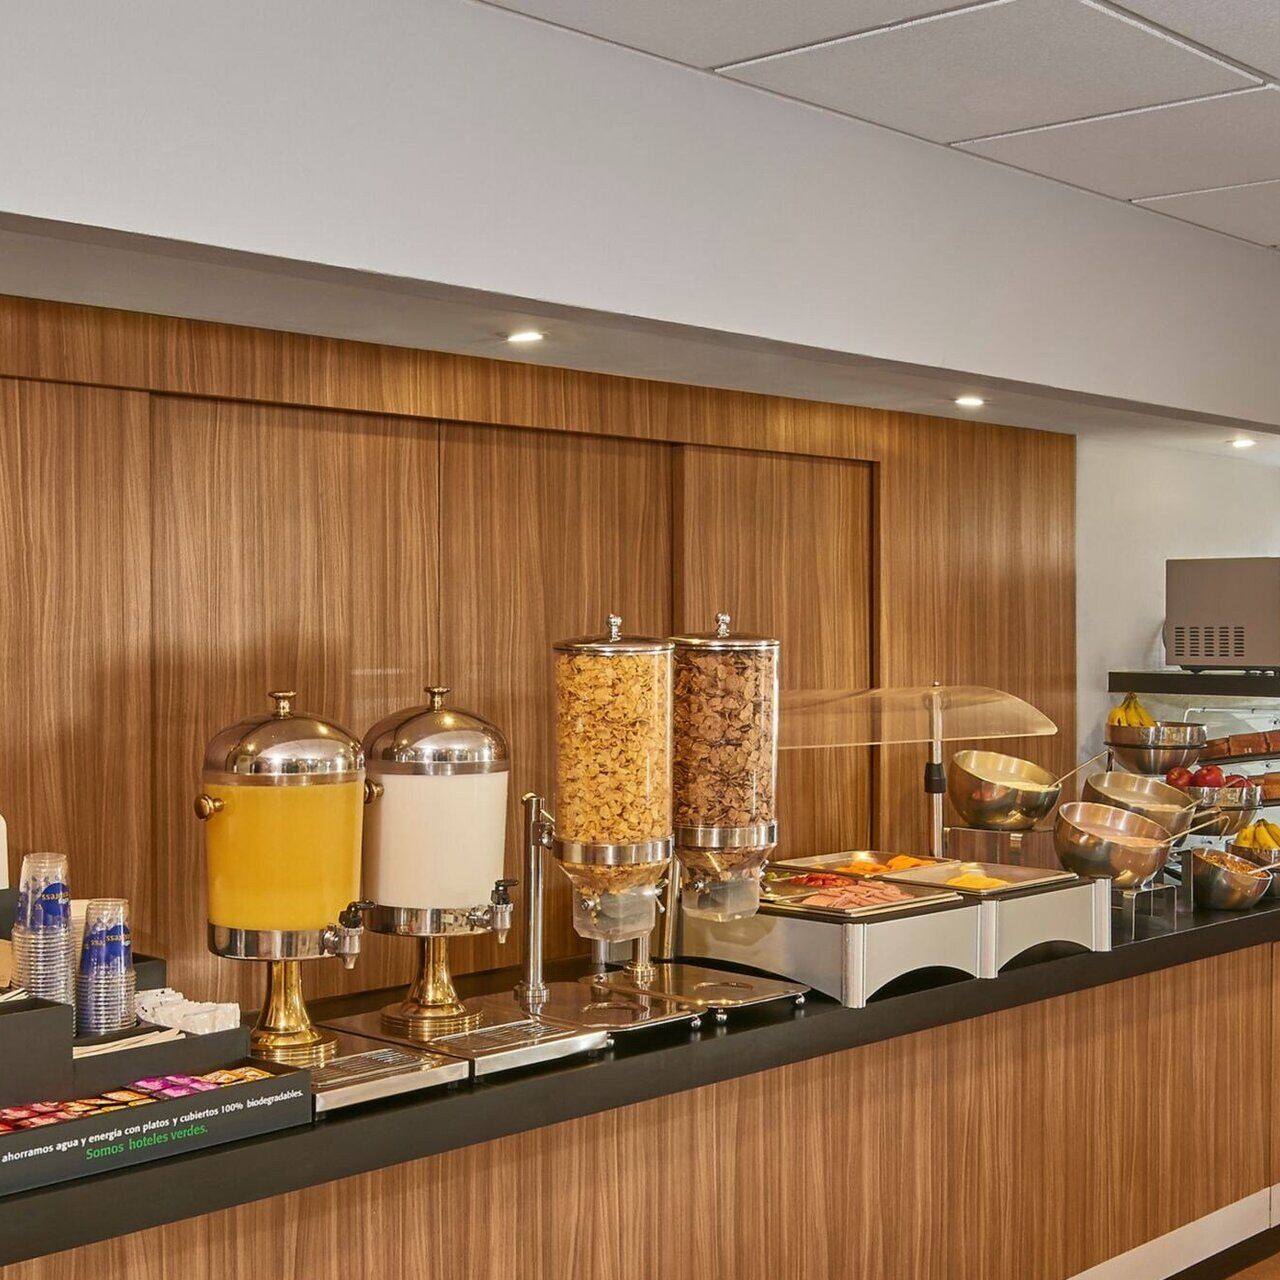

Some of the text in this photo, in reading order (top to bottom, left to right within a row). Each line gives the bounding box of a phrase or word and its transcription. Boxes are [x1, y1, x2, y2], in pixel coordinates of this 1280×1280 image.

[1, 1144, 54, 1164] ahorramos
[56, 1140, 79, 1152] agua
[81, 1137, 87, 1146] y
[88, 1128, 123, 1144] energía
[124, 1124, 141, 1135] con
[142, 1119, 170, 1133] platos
[172, 1117, 179, 1127] y
[180, 1108, 219, 1123] cubiertos
[221, 1102, 244, 1114] 100%
[246, 1089, 304, 1109] biodegradables.
[86, 1124, 208, 1161] Somos hoteles verdes.
